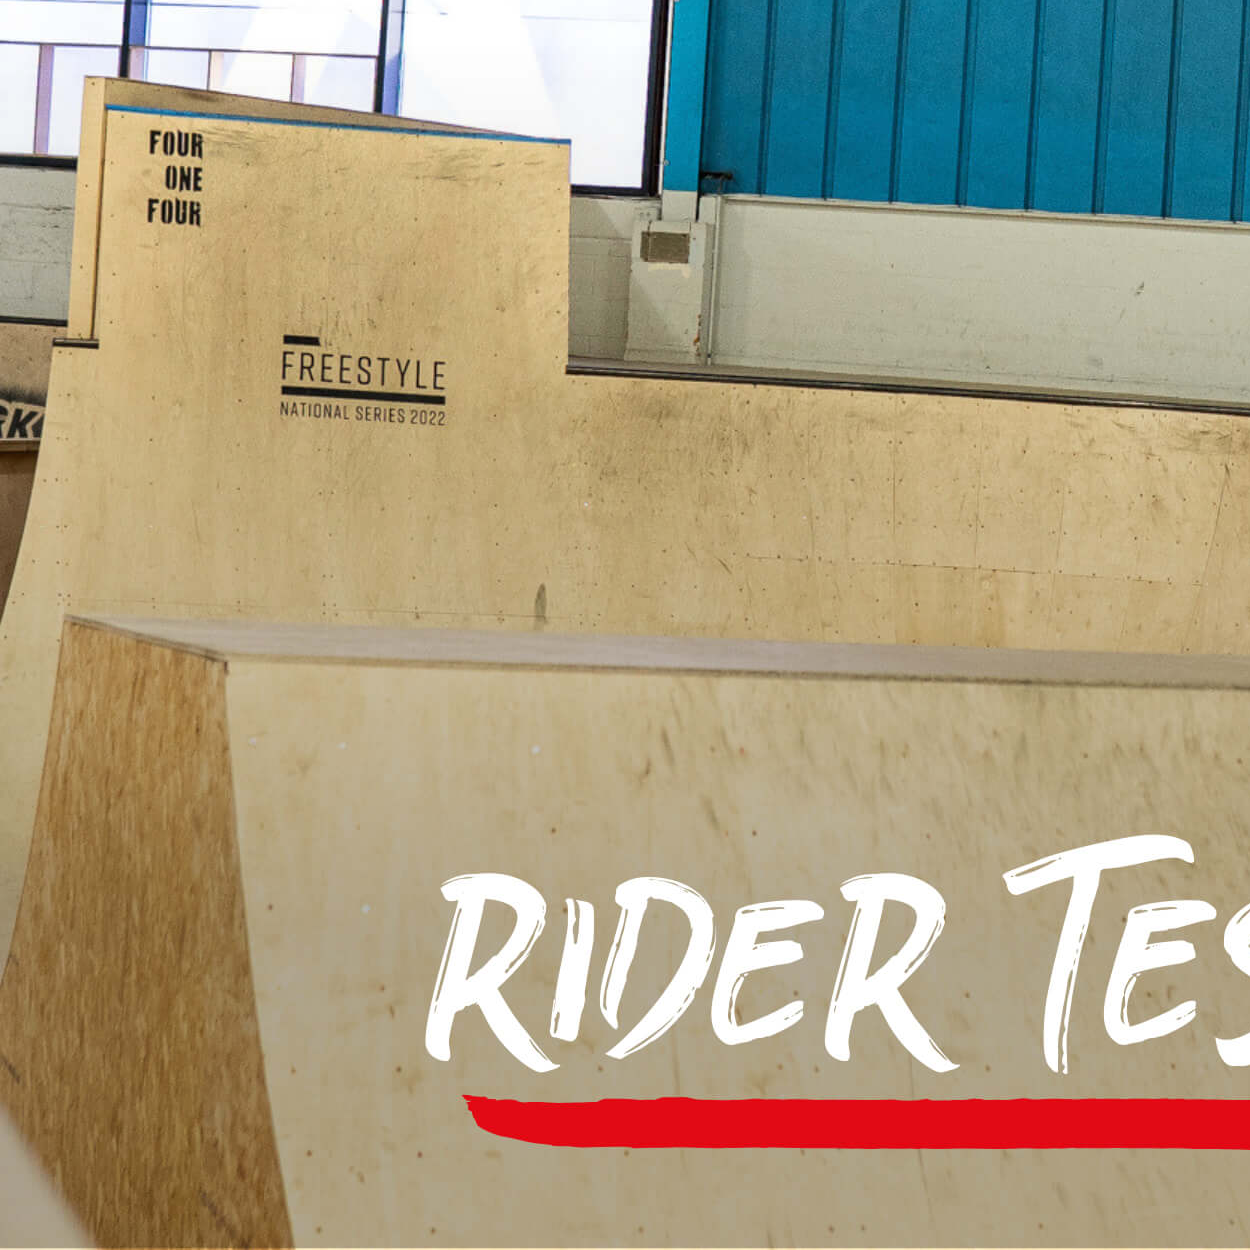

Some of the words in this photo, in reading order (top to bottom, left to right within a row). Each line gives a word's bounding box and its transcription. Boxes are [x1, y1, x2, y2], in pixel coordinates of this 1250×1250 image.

[150, 130, 203, 159] FOUR
[165, 165, 203, 192] ONE
[148, 198, 201, 227] FOUR
[281, 350, 446, 390] FREESTYLE
[280, 401, 350, 420] NATIONAL
[355, 406, 406, 423] SERIES
[410, 409, 446, 426] 2022
